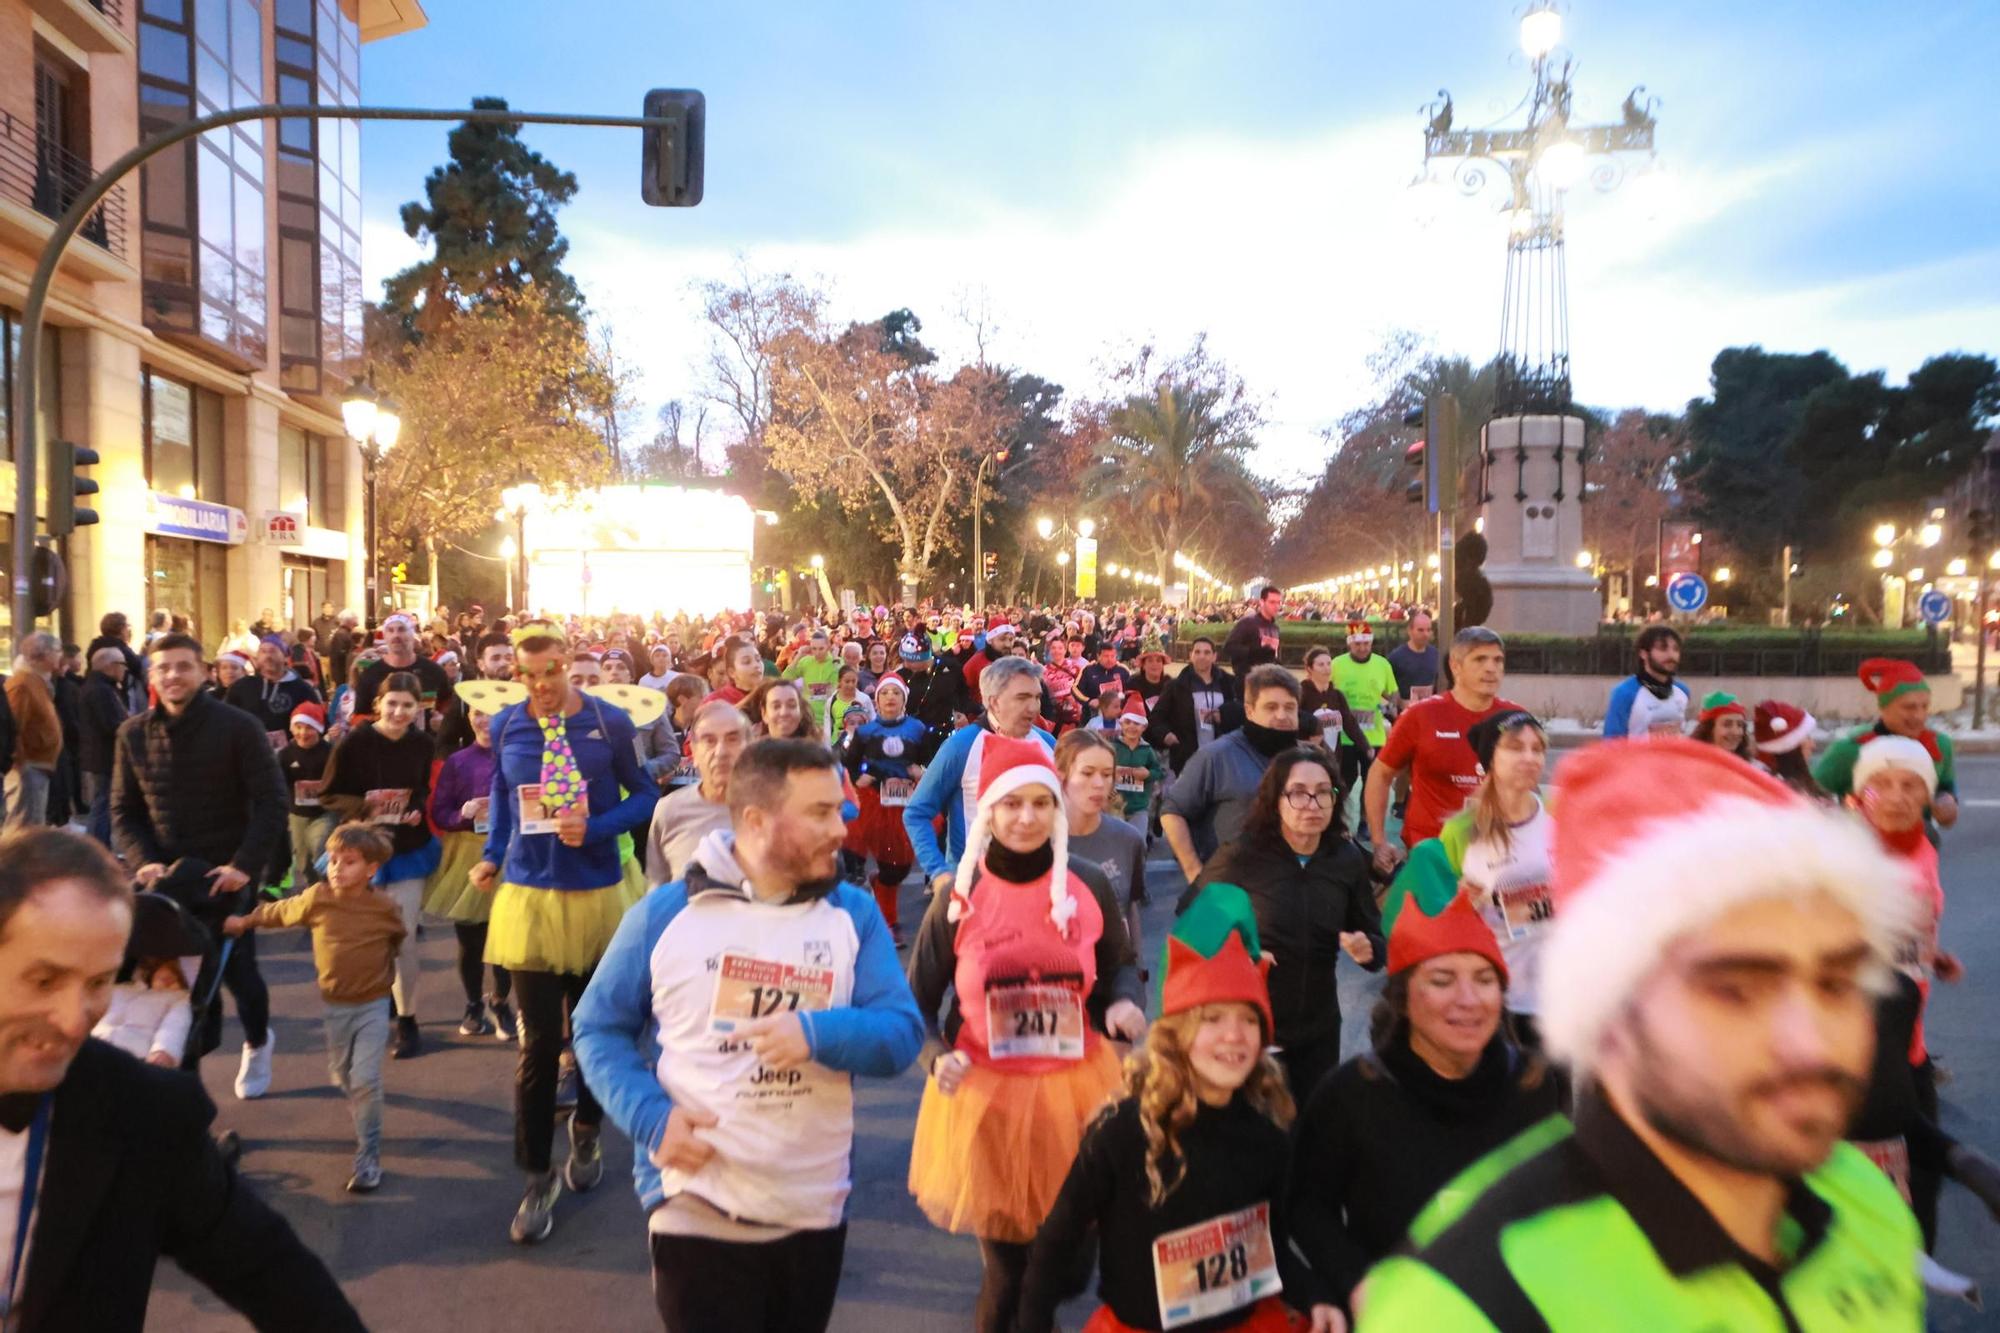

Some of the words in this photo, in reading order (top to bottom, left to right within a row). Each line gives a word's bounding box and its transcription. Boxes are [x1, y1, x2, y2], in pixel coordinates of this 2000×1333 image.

[270, 532, 296, 540] ERA
[751, 986, 800, 1018] 127
[1013, 1010, 1058, 1036] 247
[749, 1064, 802, 1086] Jeep
[1196, 1243, 1248, 1293] 128
